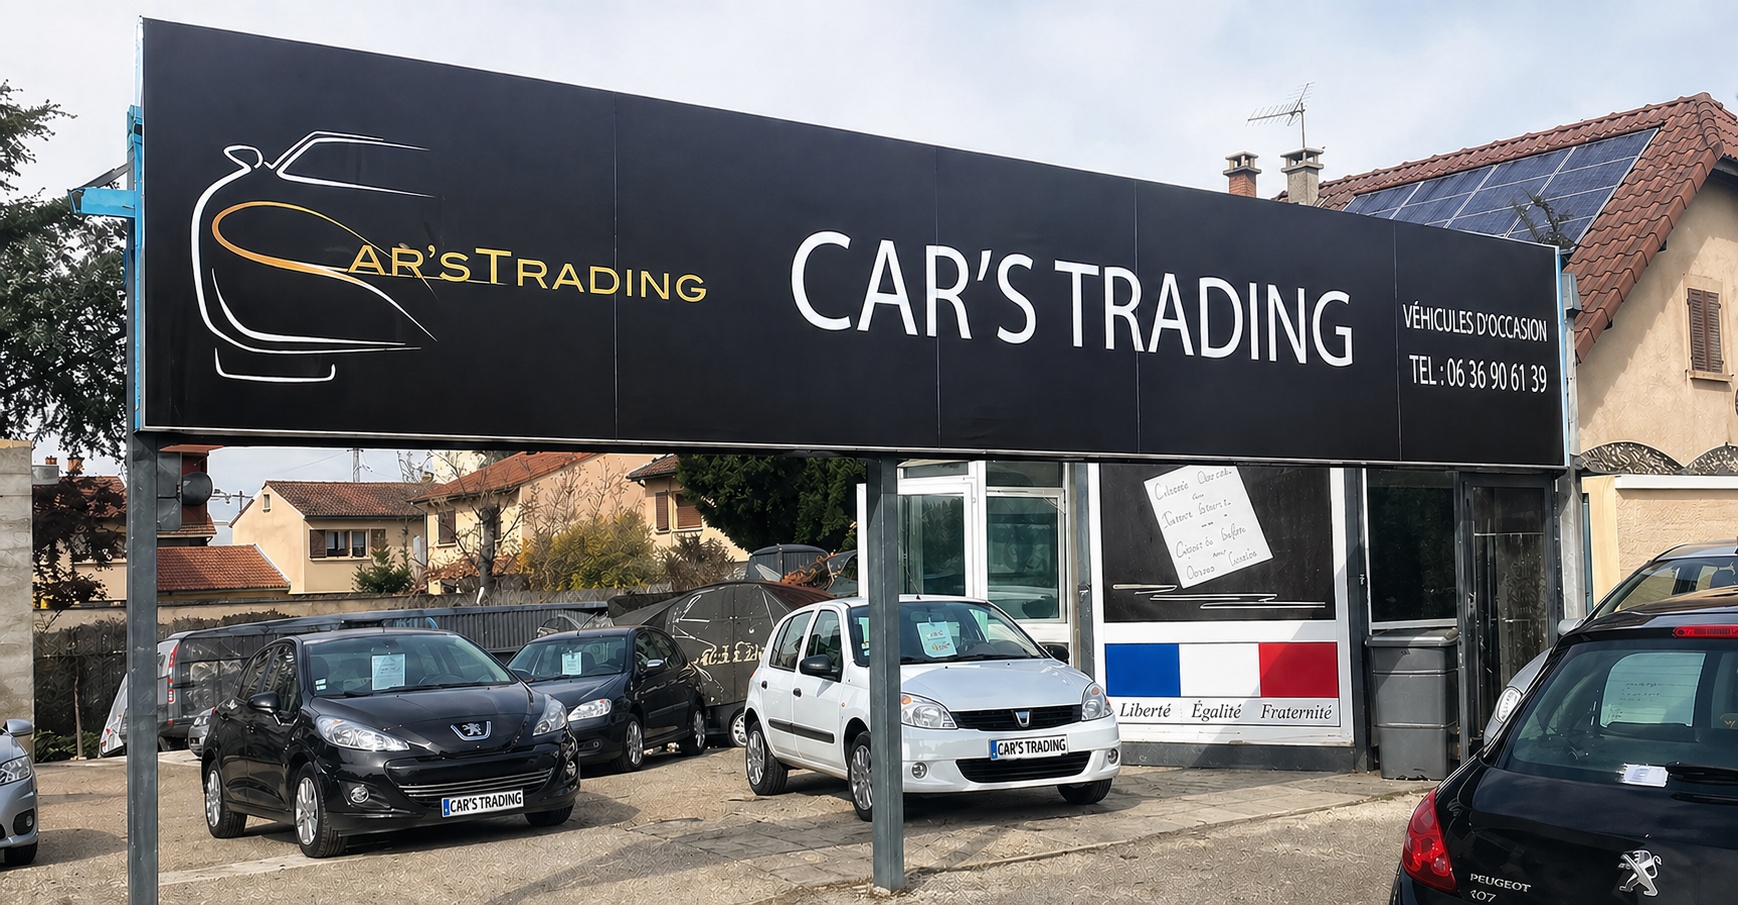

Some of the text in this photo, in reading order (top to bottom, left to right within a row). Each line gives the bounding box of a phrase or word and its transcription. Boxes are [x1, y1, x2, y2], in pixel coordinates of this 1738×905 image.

[790, 230, 1354, 367] CAR'S TRADING
[1402, 300, 1548, 342] VÉHICULES D'OCCASION
[1447, 357, 1466, 388] 06
[1468, 359, 1487, 389] 36
[1490, 361, 1507, 391] 90
[1510, 363, 1526, 392] 61
[1530, 365, 1547, 393] 39
[1119, 700, 1333, 722] Liberté Égalité Fraternité
[996, 738, 1067, 756] CAR'S TRADING
[450, 792, 521, 812] CAR'S TRADING
[1470, 873, 1532, 892] PEUGEOT
